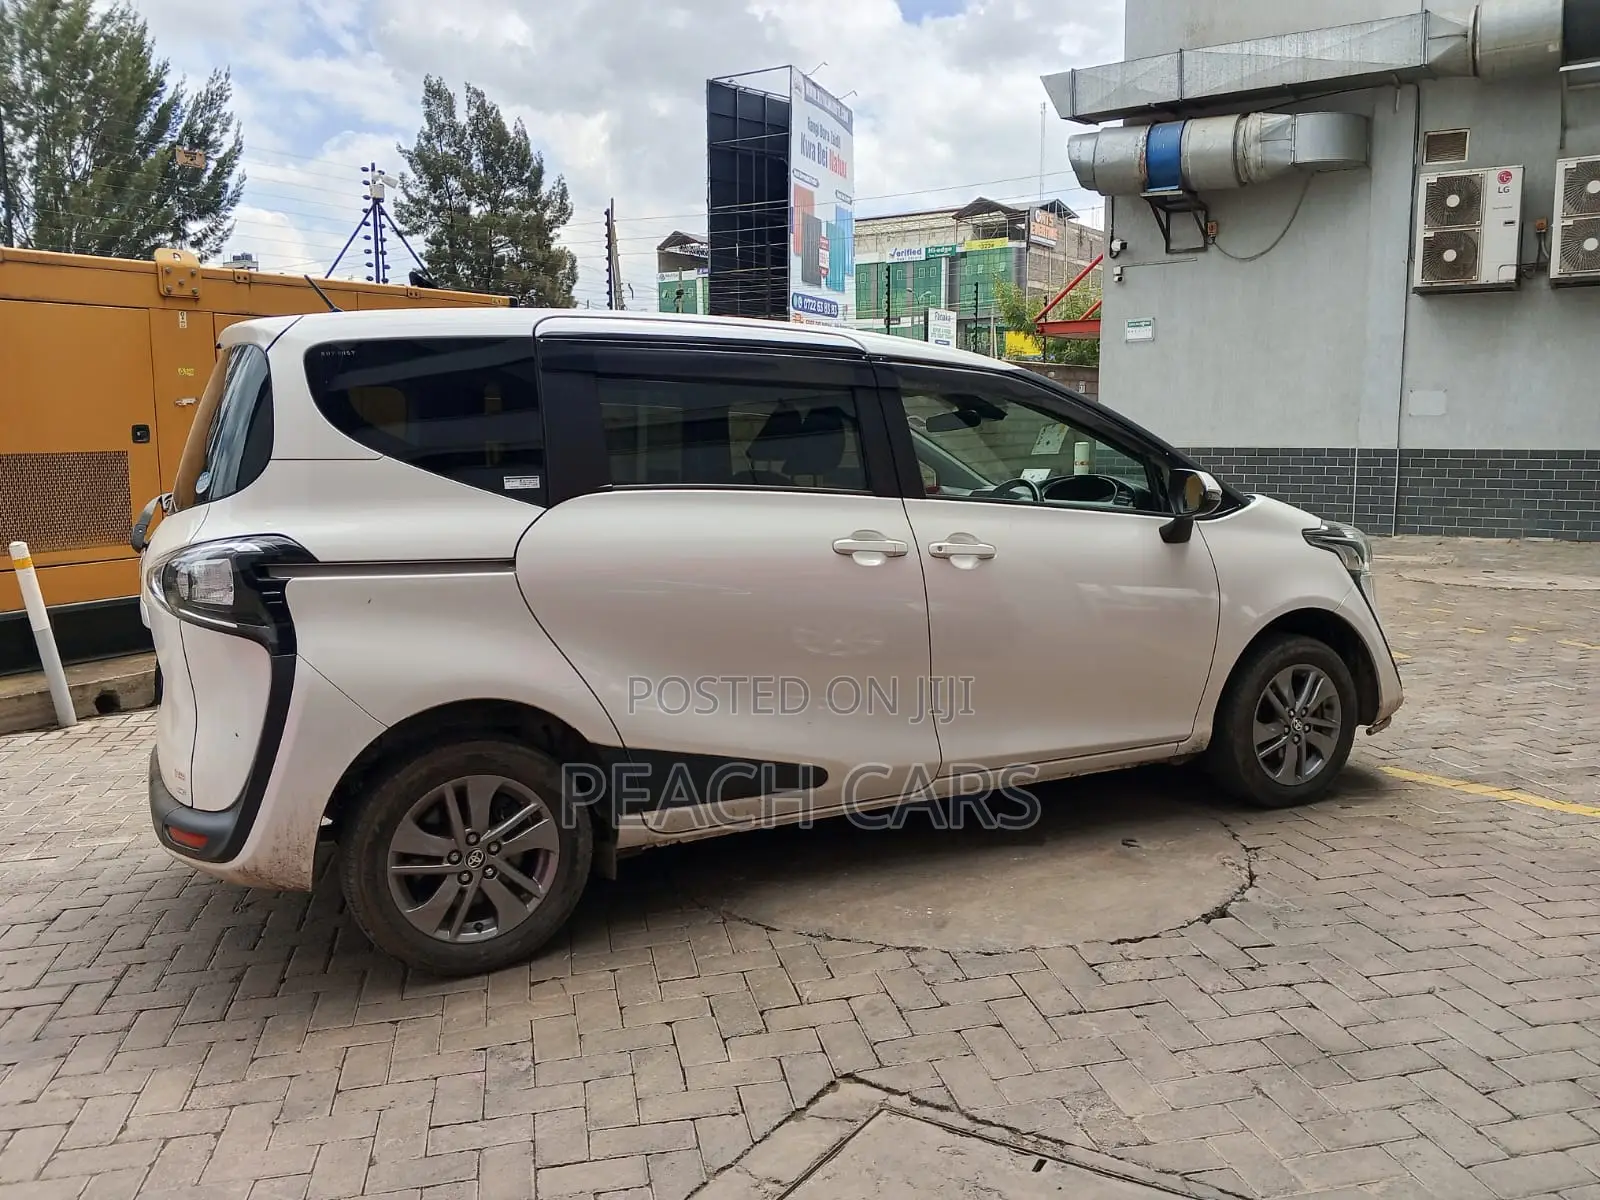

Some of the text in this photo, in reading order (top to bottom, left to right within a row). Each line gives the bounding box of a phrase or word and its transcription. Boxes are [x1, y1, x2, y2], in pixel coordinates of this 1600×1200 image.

[800, 132, 816, 162] Kwa
[817, 141, 828, 169] Bei
[1497, 186, 1510, 194] LG
